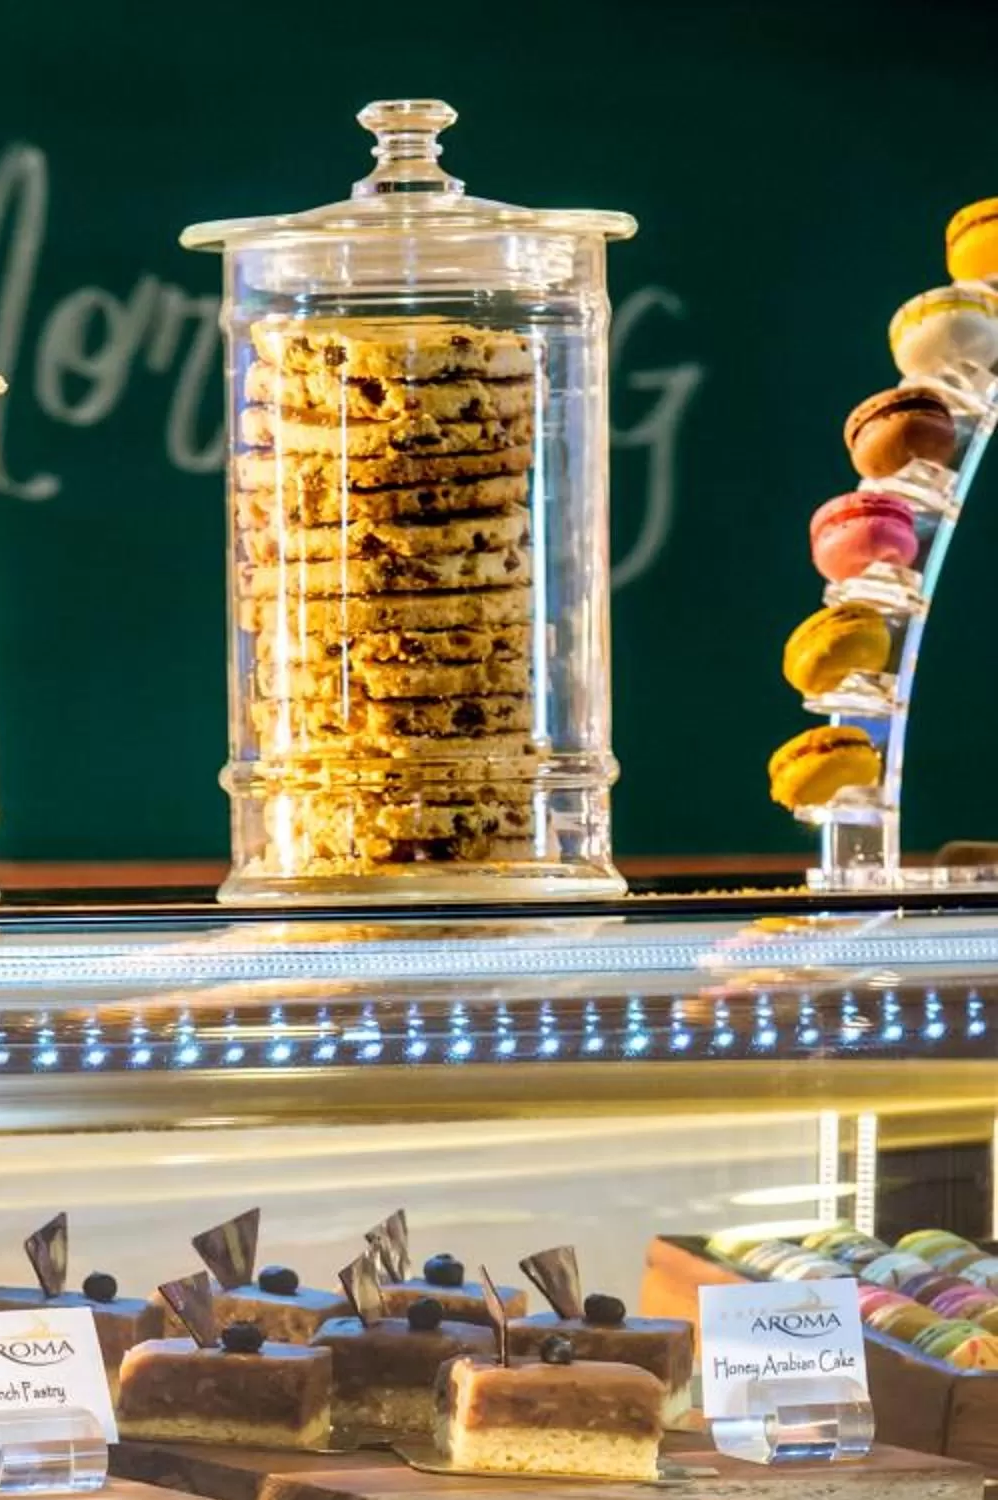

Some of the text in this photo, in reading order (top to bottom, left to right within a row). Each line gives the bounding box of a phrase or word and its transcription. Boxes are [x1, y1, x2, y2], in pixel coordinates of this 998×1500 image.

[752, 1312, 842, 1338] AROMA
[714, 1348, 856, 1382] Honey Arabian Cake
[22, 1381, 66, 1403] Pastry
